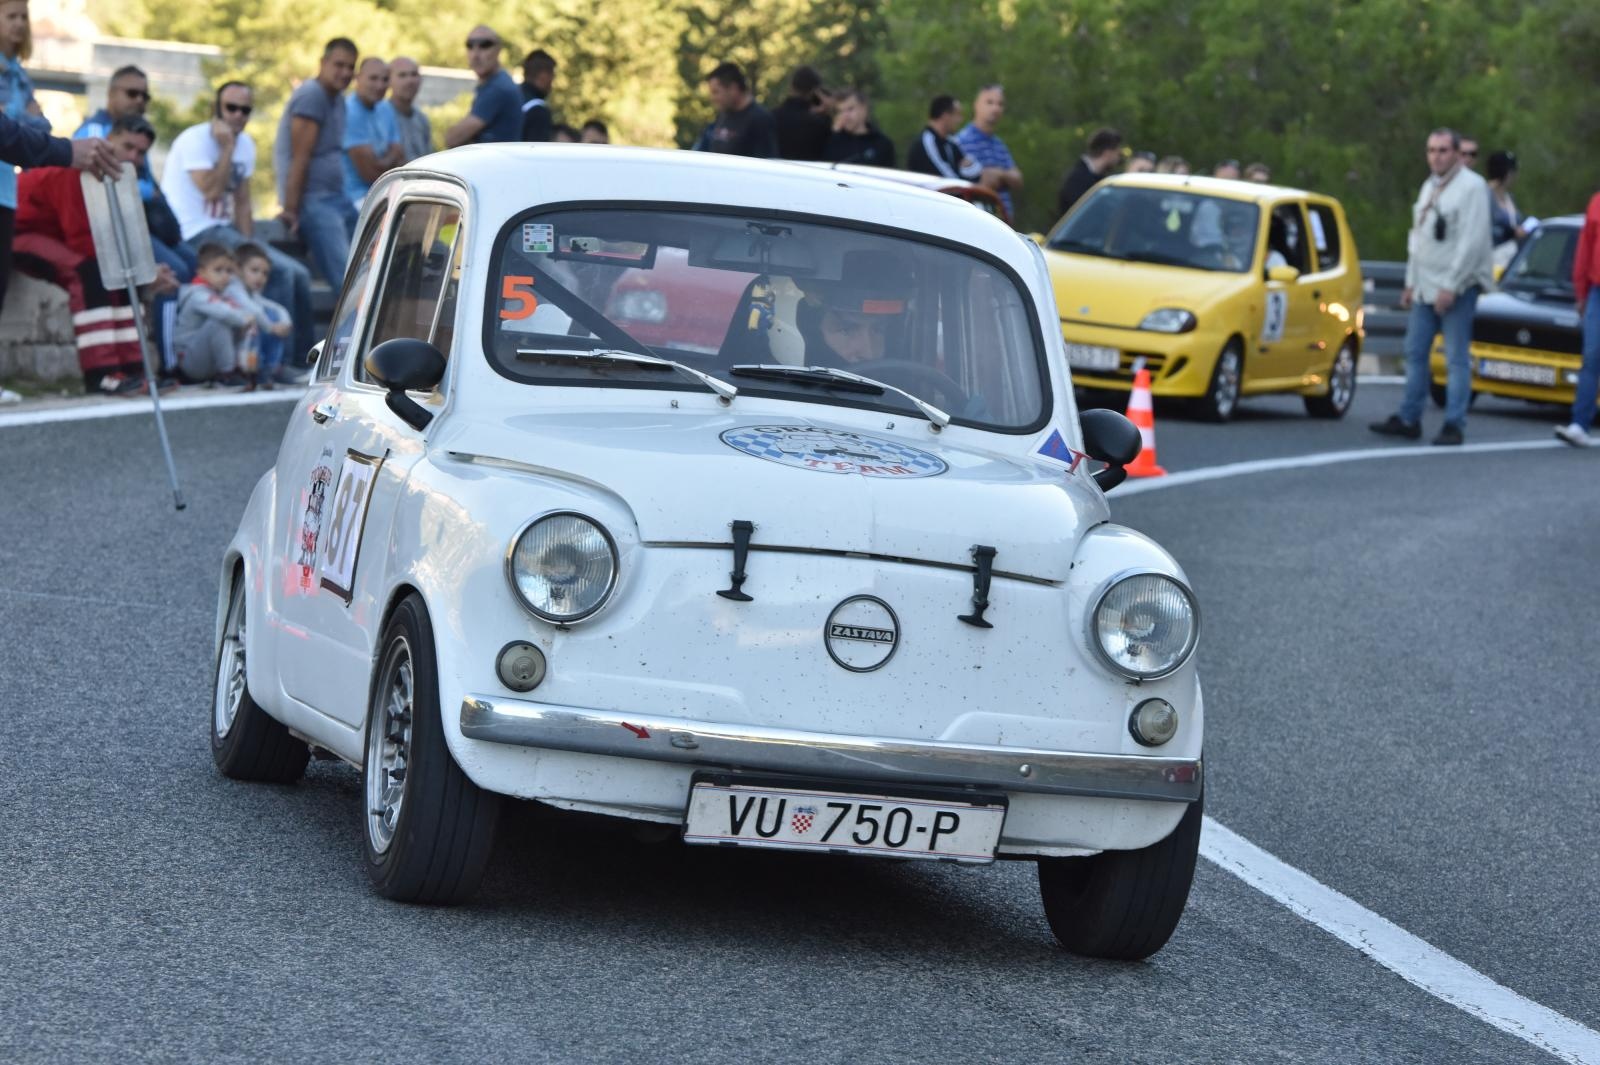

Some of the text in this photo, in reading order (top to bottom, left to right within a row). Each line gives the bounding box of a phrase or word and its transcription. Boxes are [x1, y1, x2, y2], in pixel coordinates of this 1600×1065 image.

[499, 275, 538, 320] 5
[804, 458, 918, 475] TEAM
[327, 472, 367, 575] 87
[832, 625, 892, 641] ZASTAVA
[729, 794, 961, 851] VU 750-P
